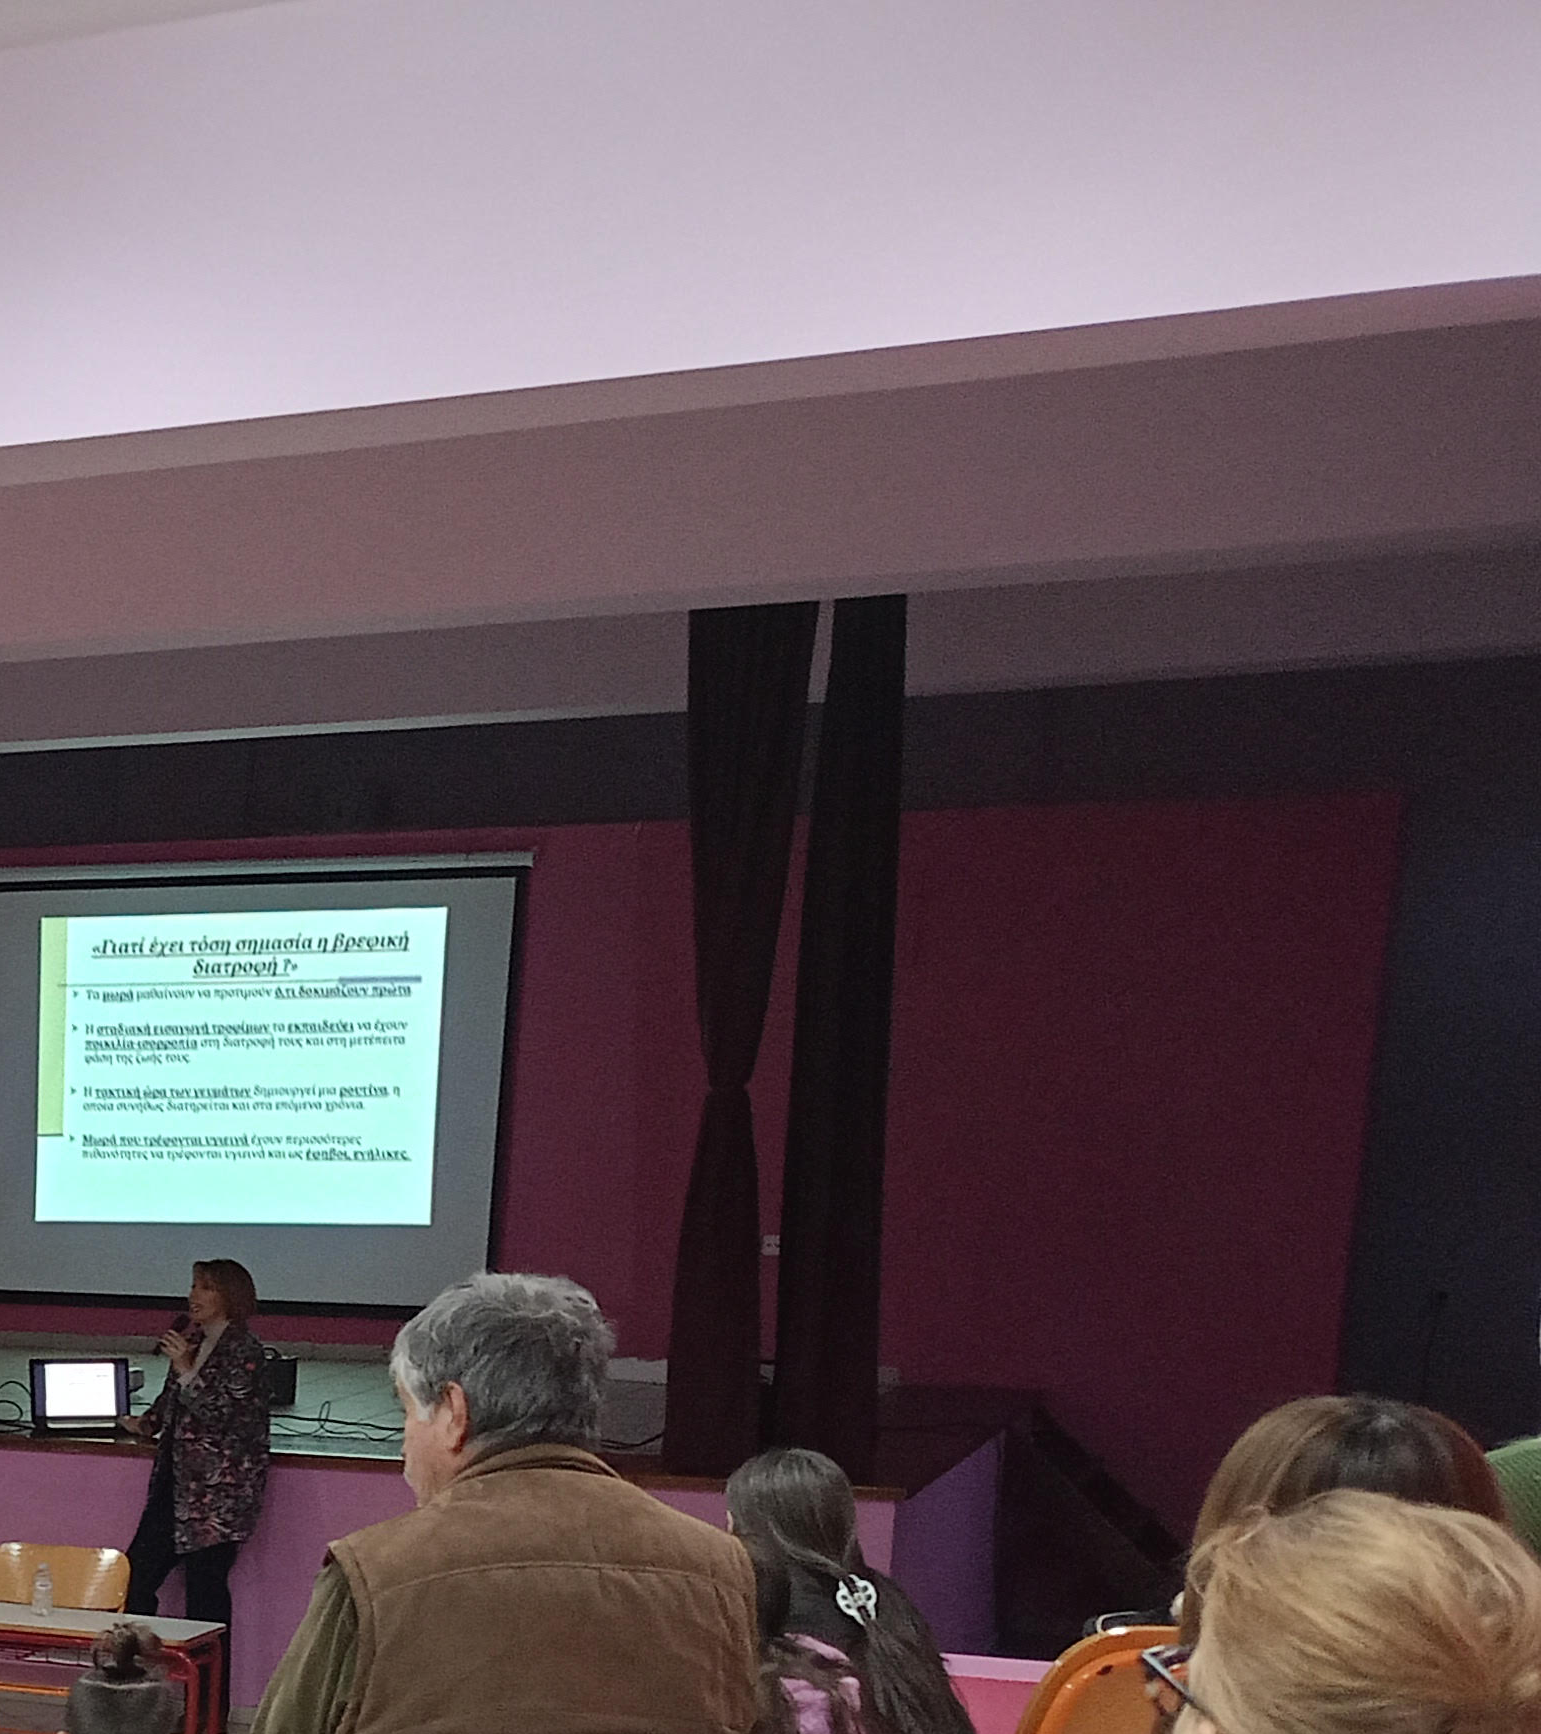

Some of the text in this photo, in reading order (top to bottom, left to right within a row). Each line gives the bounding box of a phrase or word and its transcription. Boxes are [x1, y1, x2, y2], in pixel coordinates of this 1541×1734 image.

[92, 930, 410, 957] «Γιατί έχει τόση σημασία η βρεφική
[193, 956, 278, 978] διατροφή
[86, 989, 100, 1000] Τα
[102, 988, 134, 1002] μωρά
[137, 987, 195, 1001] μαθαίνουν
[197, 989, 211, 999] να
[214, 987, 272, 1001] προτιμούν
[299, 984, 368, 998] δοκιμάζουν
[371, 984, 411, 998] πρώτα
[85, 1024, 94, 1035] Η
[96, 1022, 151, 1037] σταδιακή
[153, 1021, 209, 1036] εισαγωγή
[212, 1020, 270, 1036] τροφίμων
[287, 1019, 354, 1034] εκπαιδεύει
[357, 1022, 371, 1032] να
[374, 1018, 408, 1033] έχουν
[200, 1039, 221, 1049] στη
[223, 1034, 275, 1049] διατροφή
[278, 1037, 304, 1048] τους
[306, 1036, 324, 1046] και
[327, 1036, 347, 1048] στη
[349, 1034, 405, 1048] μετέπειτα
[85, 1052, 113, 1065] φάση
[117, 1054, 133, 1065] της
[135, 1051, 162, 1065] ζωής
[83, 1086, 92, 1098] Η
[95, 1085, 140, 1100] τακτική
[143, 1085, 167, 1100] ώρα
[169, 1087, 192, 1099] των
[254, 1084, 315, 1098] δημιουργεί
[318, 1086, 336, 1098] μια
[117, 1100, 164, 1113] συνήθως
[167, 1099, 229, 1113] διατηρείται
[232, 1101, 250, 1111] και
[253, 1101, 272, 1111] στα
[275, 1099, 322, 1113] επόμενα
[82, 1133, 116, 1147] Μωρά
[119, 1135, 141, 1147] που
[143, 1134, 201, 1147] τρέφονται
[251, 1133, 283, 1147] έχουν
[285, 1133, 362, 1147] περισσότερες
[82, 1147, 148, 1161] πιθανότητες
[151, 1150, 164, 1160] να
[167, 1148, 222, 1161] τρέφονται
[268, 1150, 285, 1159] και
[288, 1150, 303, 1161] ως
